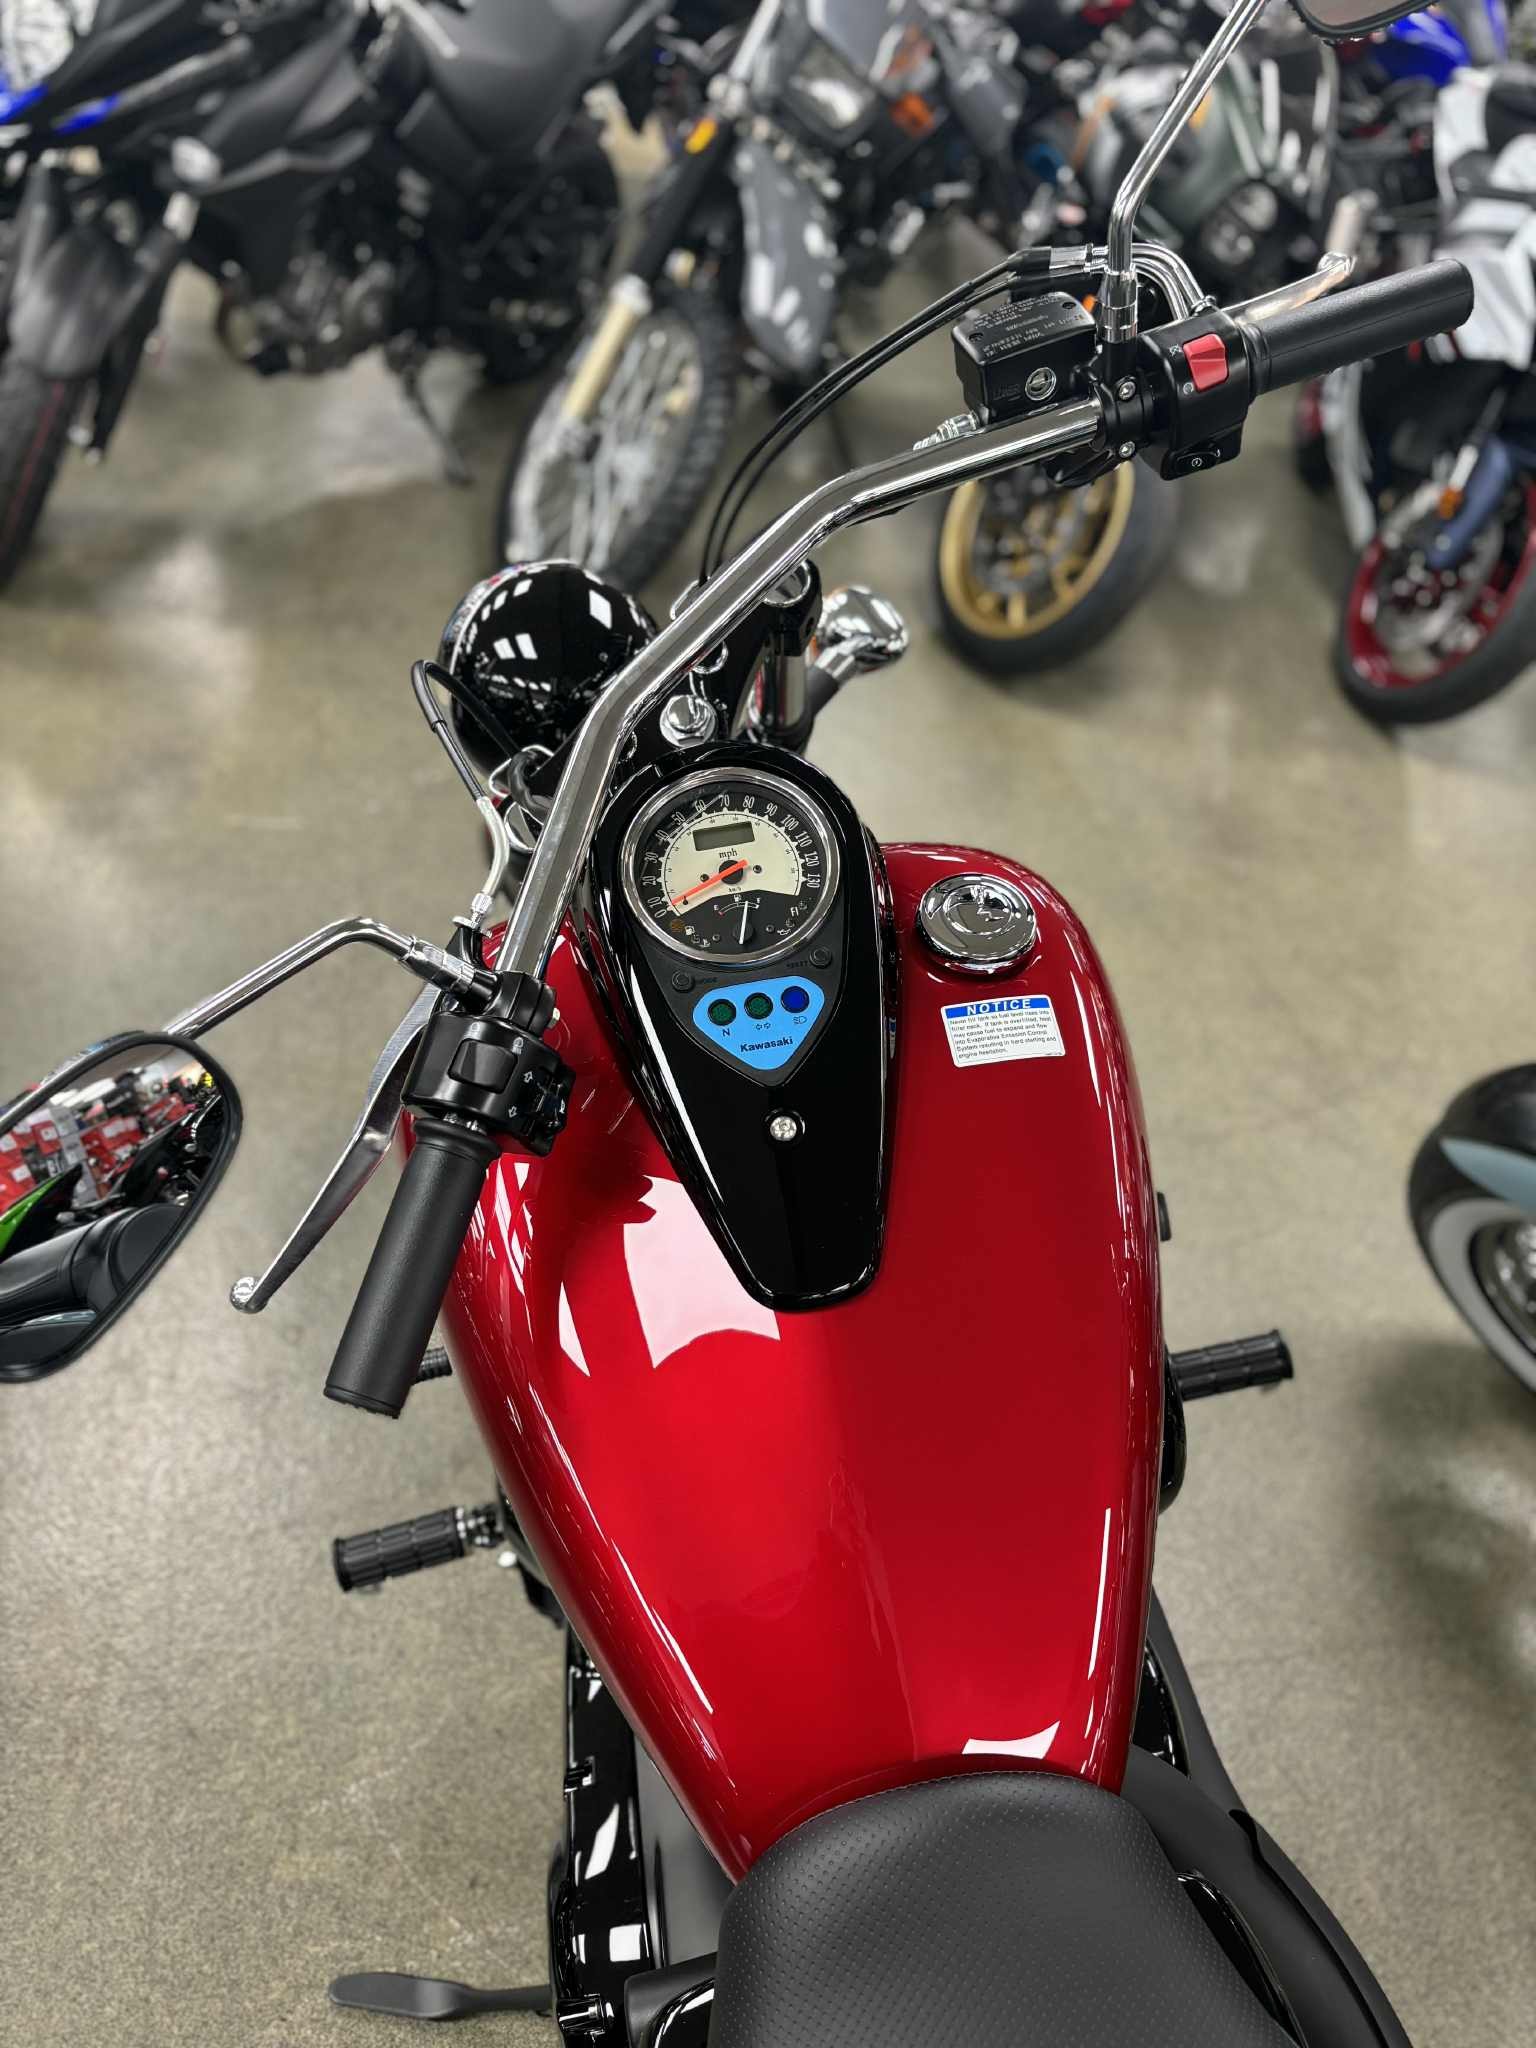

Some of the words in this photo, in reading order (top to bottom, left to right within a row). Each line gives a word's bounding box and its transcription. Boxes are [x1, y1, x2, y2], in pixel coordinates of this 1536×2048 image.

[694, 799, 707, 811] 60
[720, 795, 730, 807] 70
[742, 795, 755, 809] 80
[766, 802, 778, 816] 90
[671, 811, 686, 825] 50
[781, 814, 799, 831] 100
[795, 830, 813, 848] 110
[645, 852, 659, 864] 30
[718, 849, 738, 860] mph
[804, 850, 820, 867] 120
[642, 875, 657, 886] 20
[806, 873, 821, 888] 130
[647, 897, 662, 909] 10
[654, 908, 667, 918] 0
[967, 999, 1031, 1015] NOTICE
[721, 1028, 731, 1037] N
[740, 1036, 794, 1053] Kawasaki
